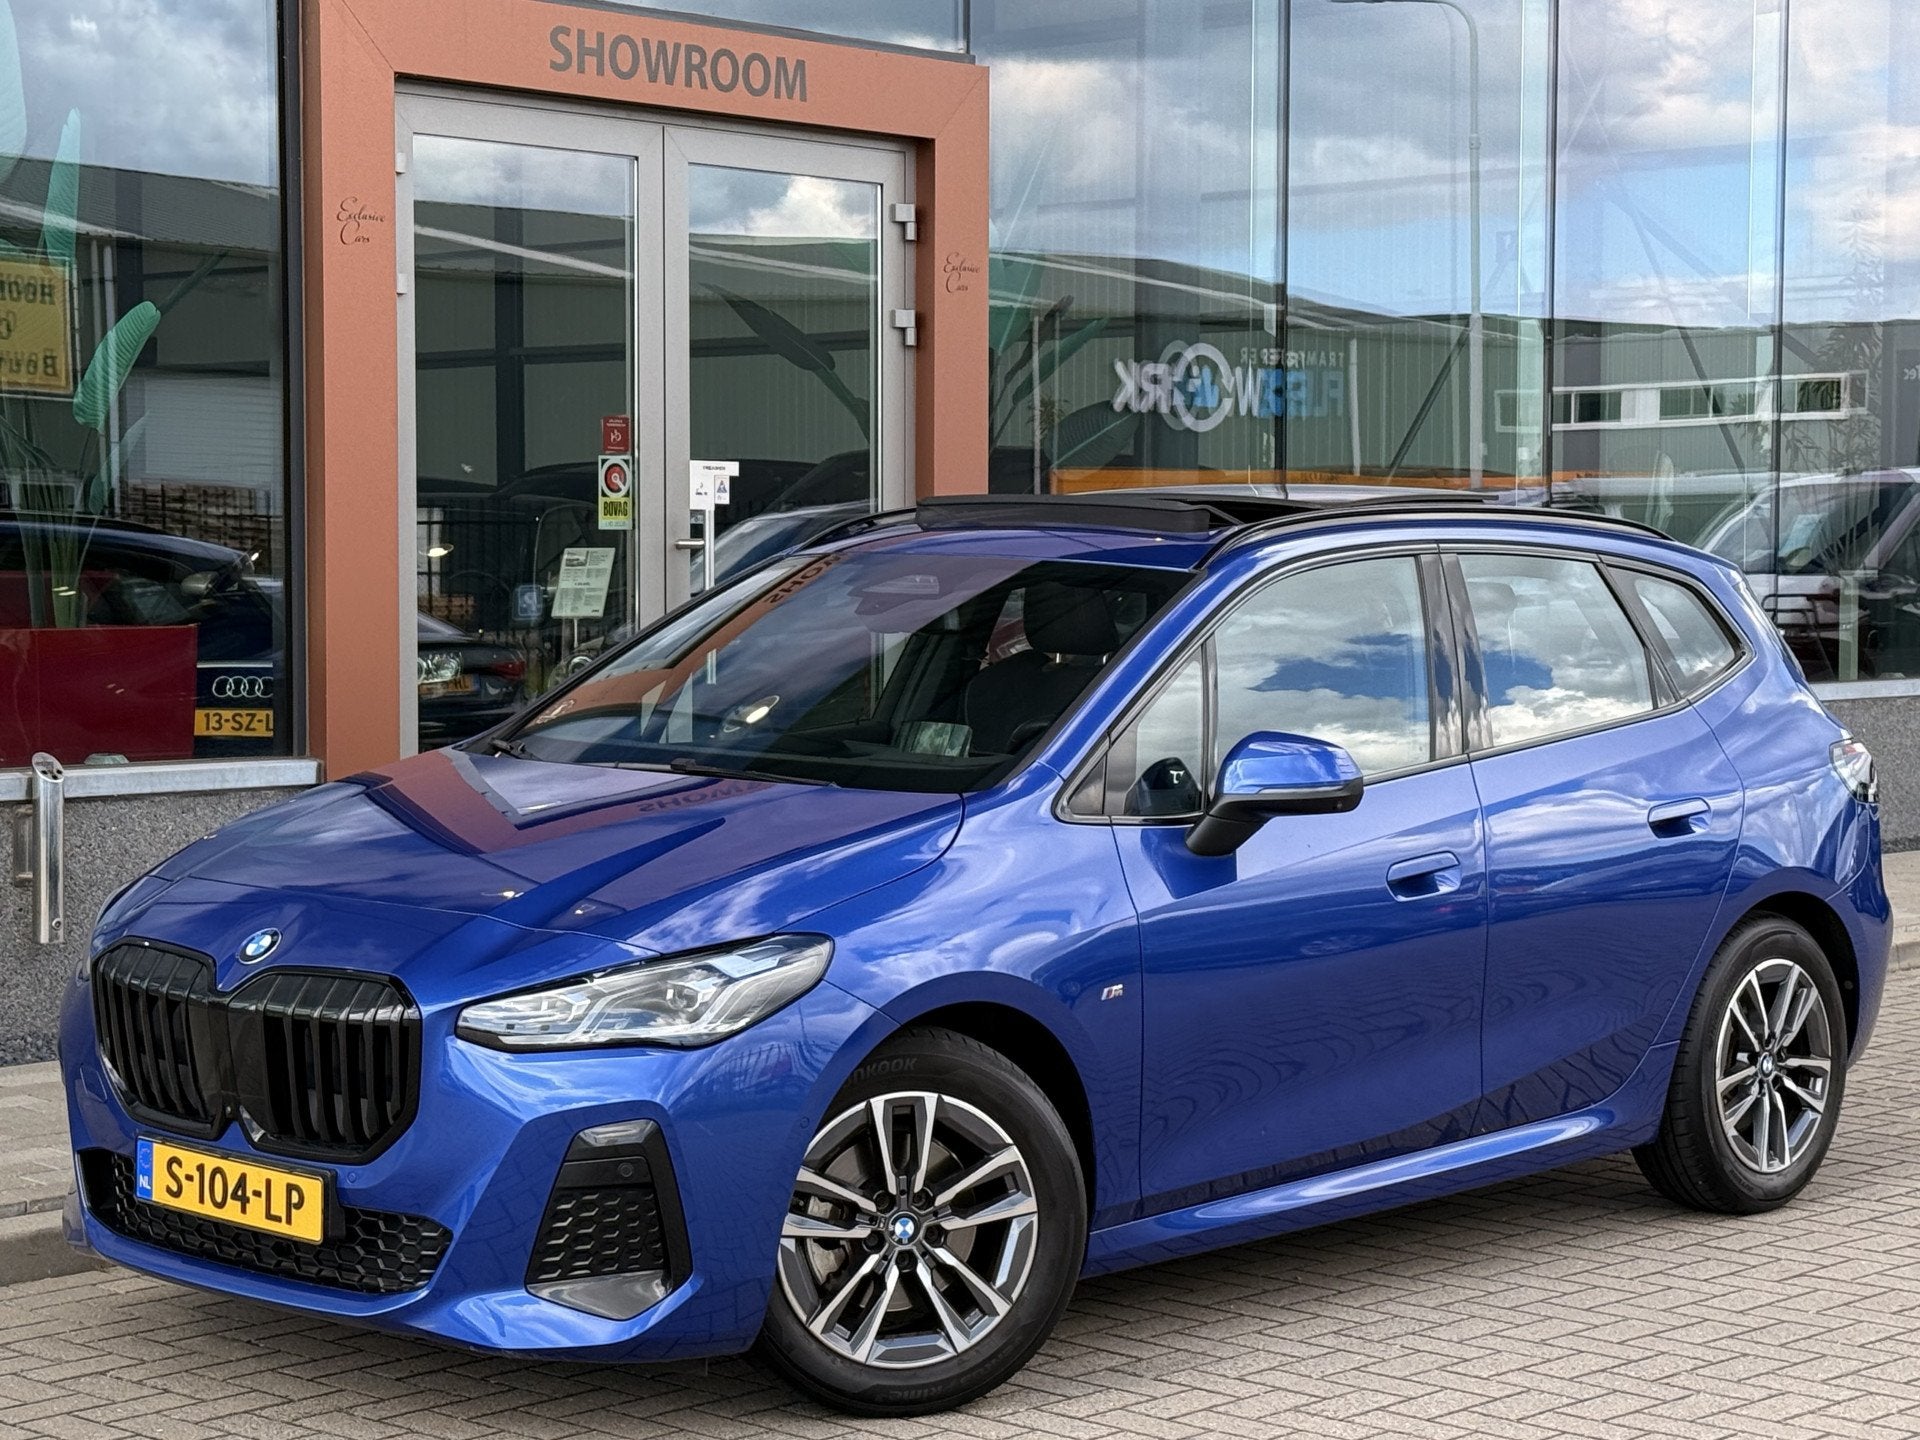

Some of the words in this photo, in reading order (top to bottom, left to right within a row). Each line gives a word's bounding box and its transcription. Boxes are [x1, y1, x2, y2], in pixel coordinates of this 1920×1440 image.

[549, 25, 808, 103] SHOWROOM
[603, 501, 629, 517] BOVAG
[139, 1174, 152, 1190] NL
[165, 1156, 305, 1226] S-104-LP
